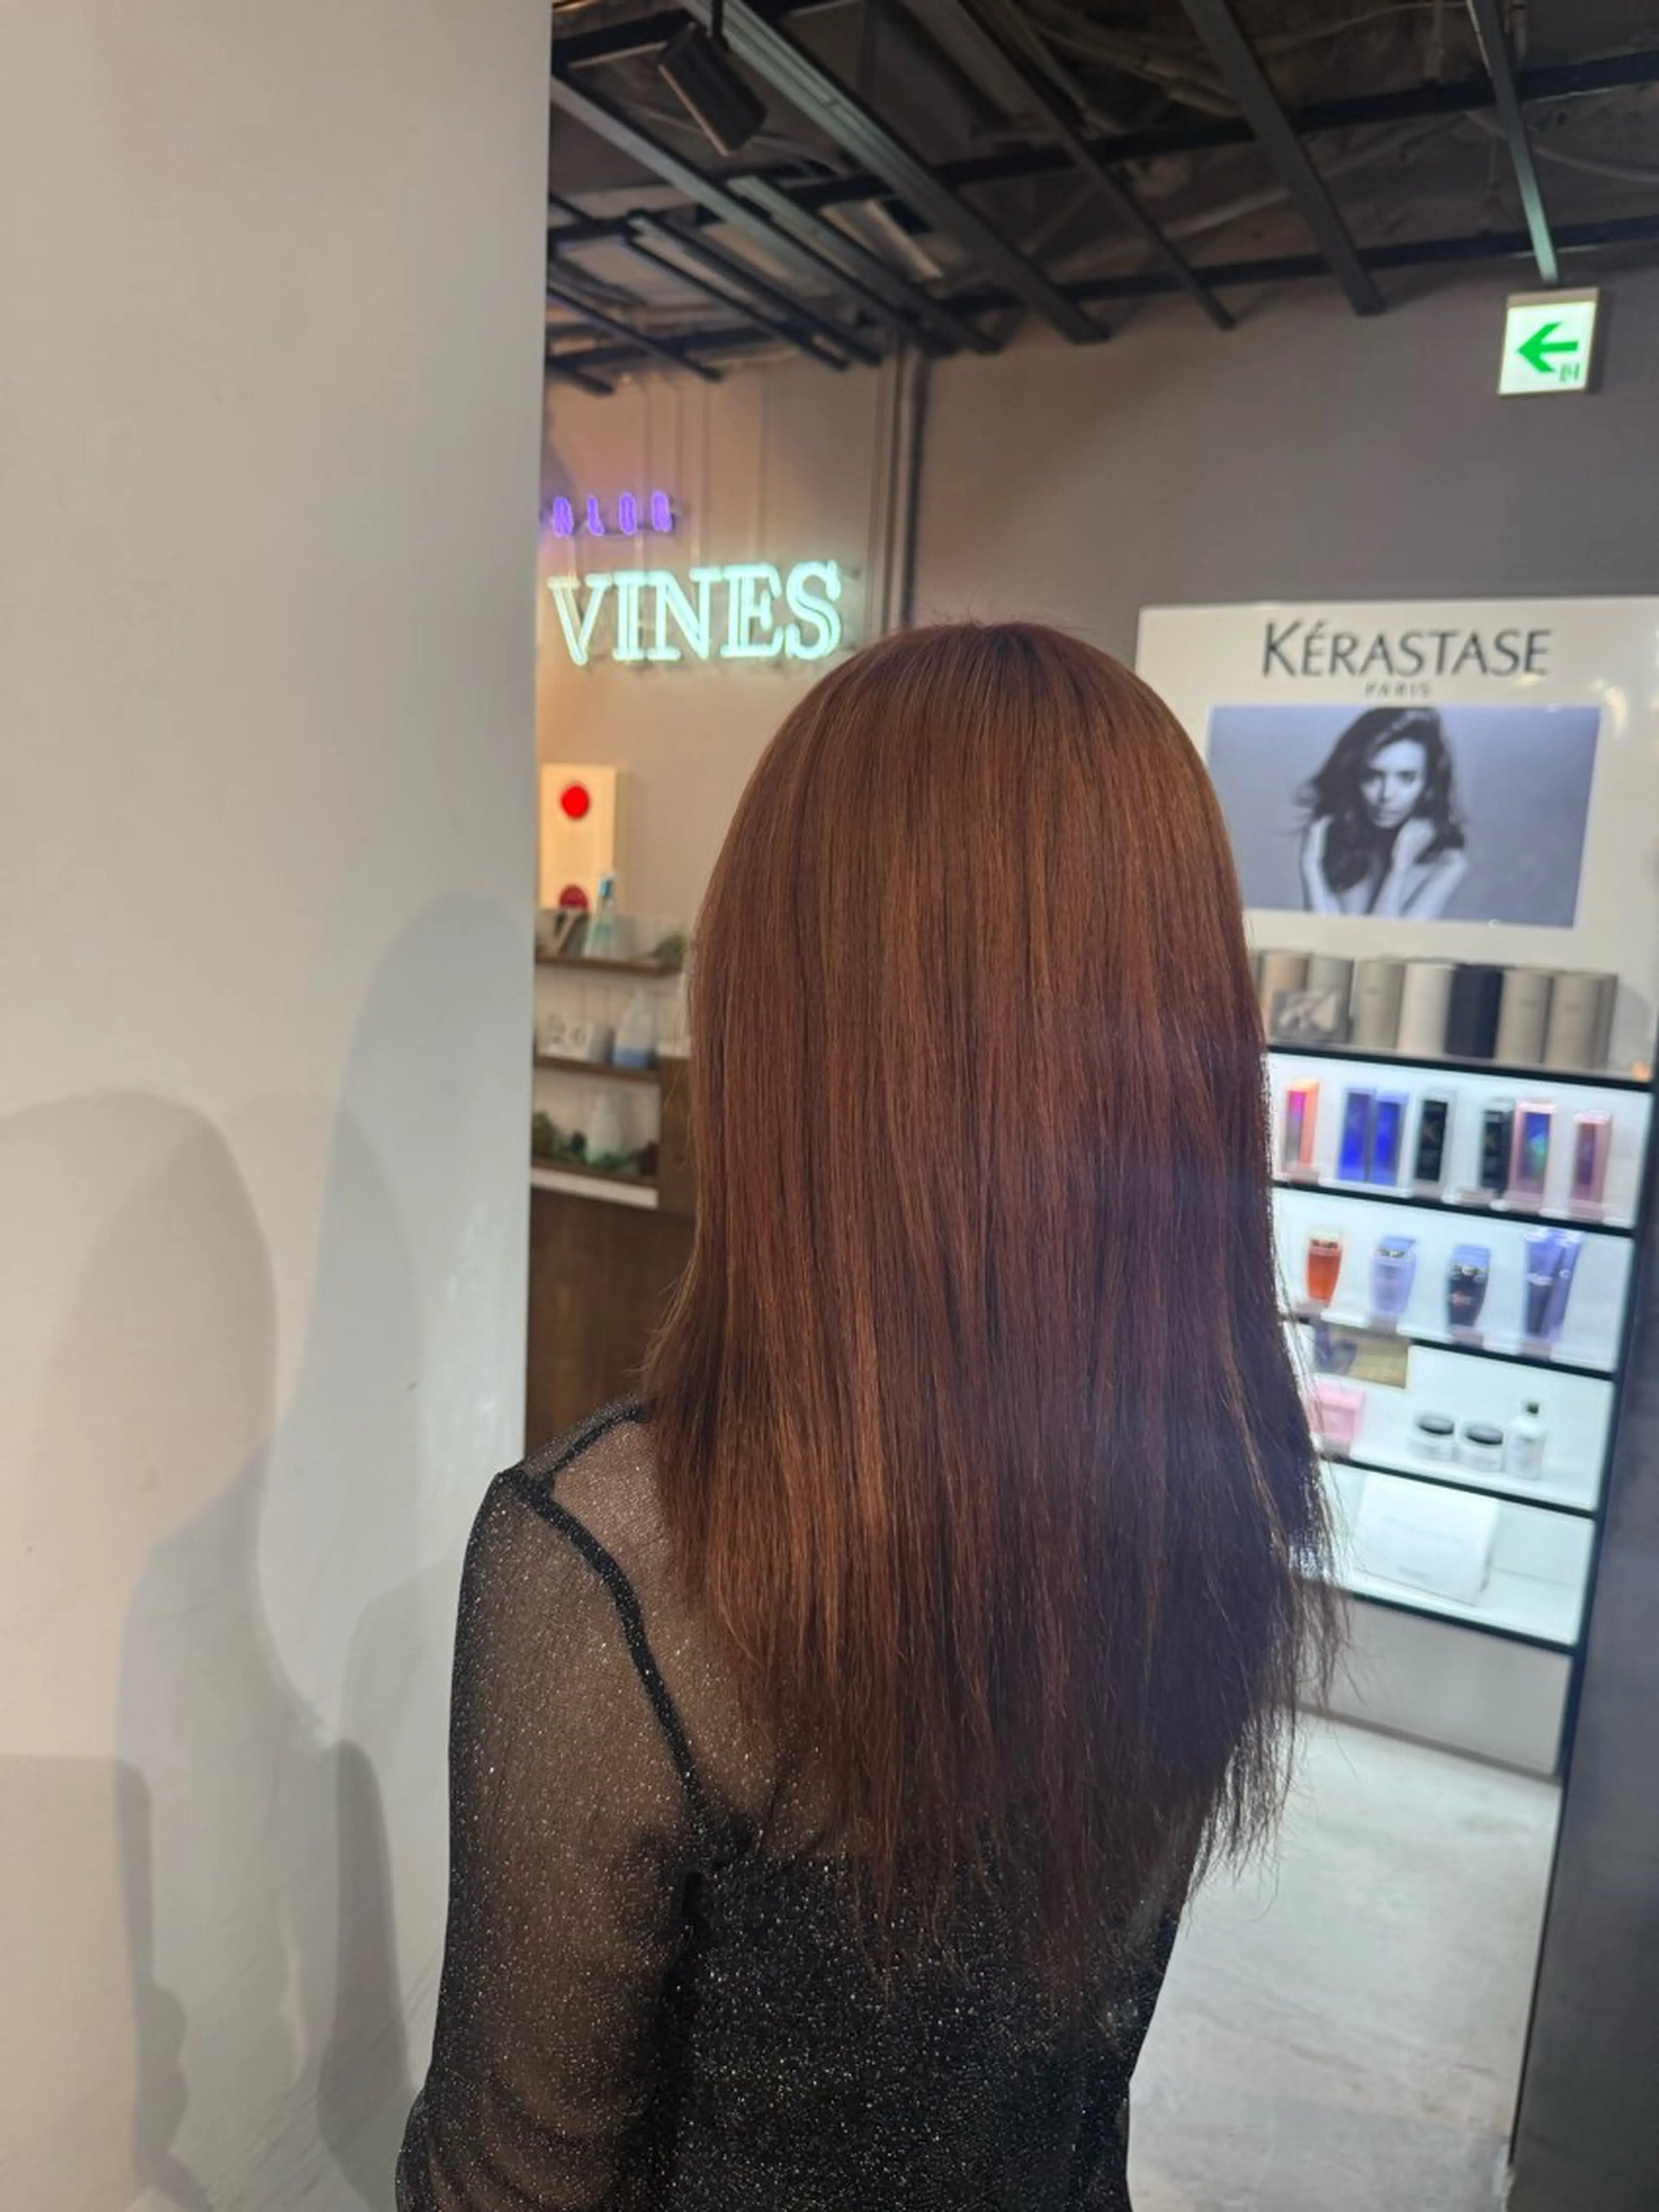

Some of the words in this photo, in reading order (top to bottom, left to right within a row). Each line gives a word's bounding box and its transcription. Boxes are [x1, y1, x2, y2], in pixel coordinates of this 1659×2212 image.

[547, 561, 842, 666] VINES
[1262, 620, 1552, 677] KÉRASTASE
[1365, 681, 1431, 699] PARIS
